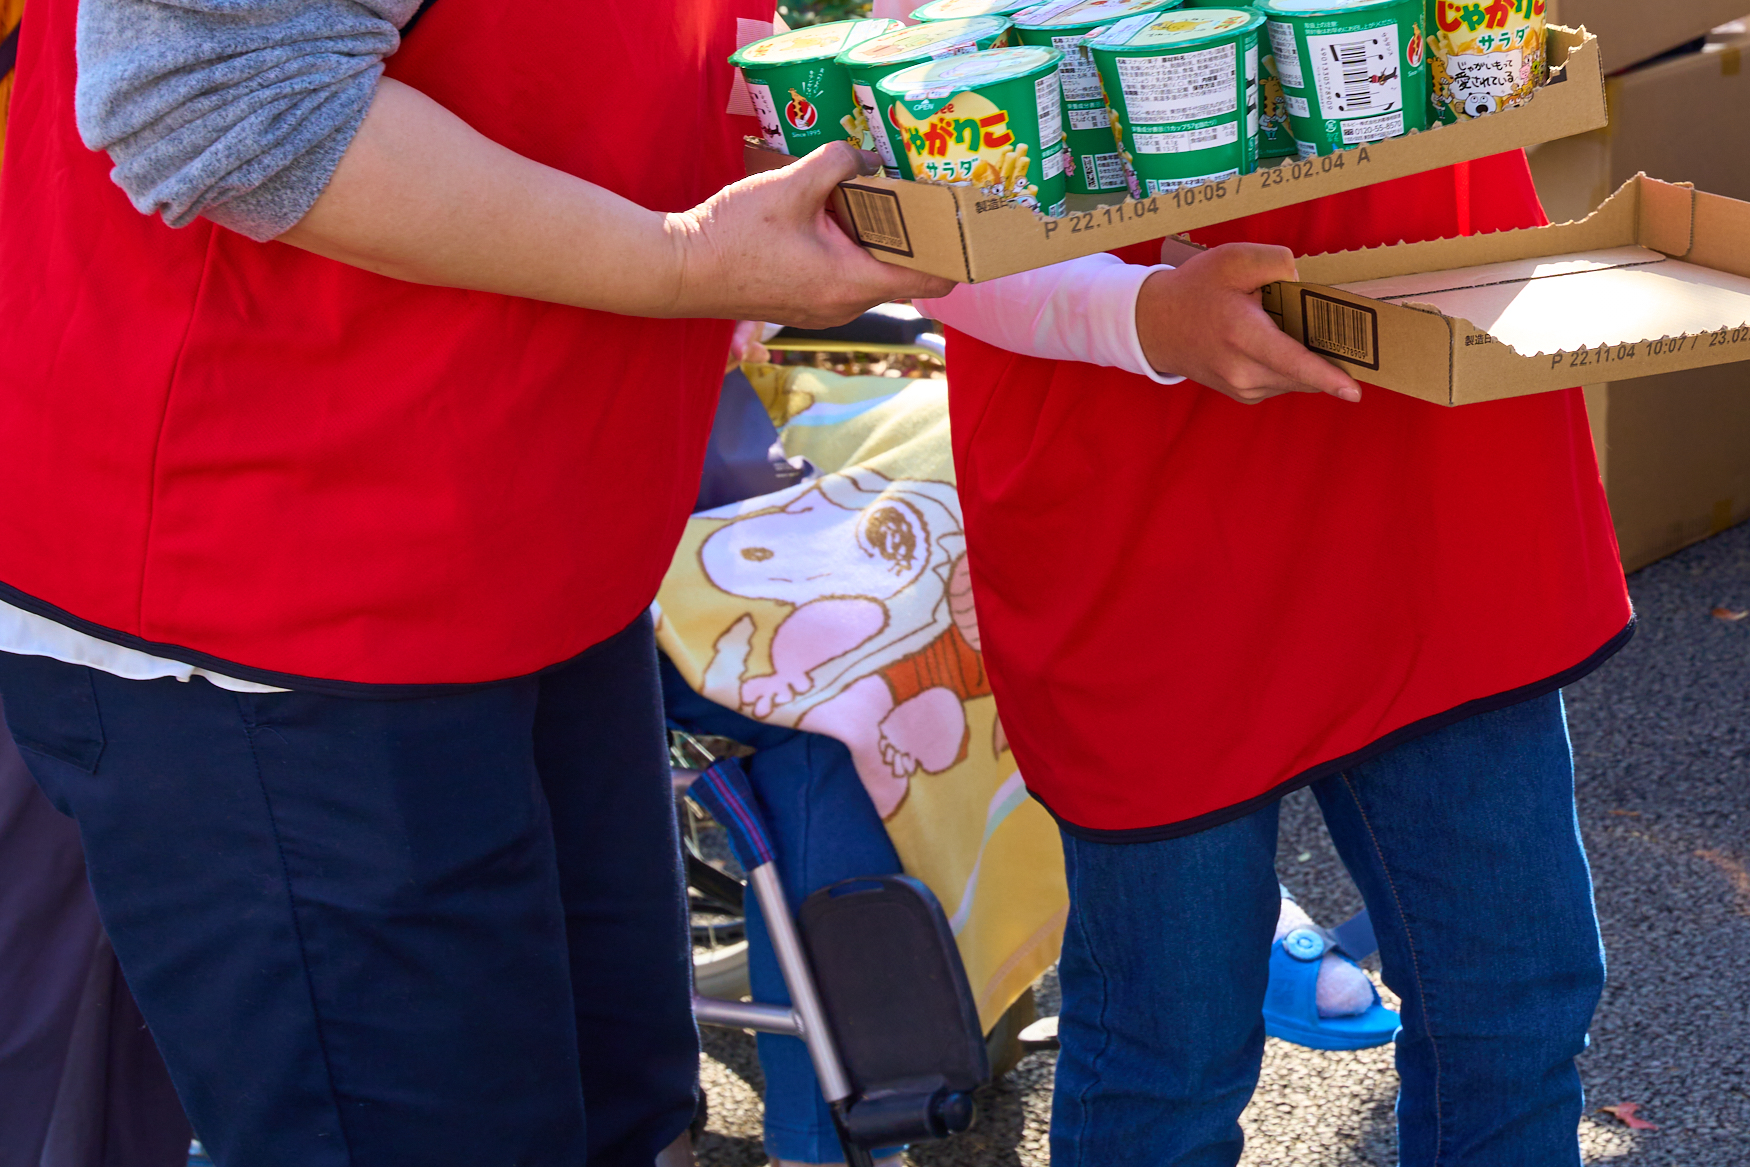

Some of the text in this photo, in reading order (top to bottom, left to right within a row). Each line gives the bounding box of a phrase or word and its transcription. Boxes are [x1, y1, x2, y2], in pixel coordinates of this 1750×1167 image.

[1478, 25, 1530, 52] サラダ
[1457, 59, 1513, 72] じゃがいもって
[1454, 70, 1514, 91] 愛されている
[913, 102, 934, 111] OPEN
[926, 156, 980, 179] サラダ
[1045, 221, 1058, 239] P
[1070, 198, 1159, 234] 22.11.04
[1172, 180, 1228, 209] 10:05
[1260, 152, 1344, 189] 23.02.04
[1357, 146, 1371, 165] A
[1551, 353, 1563, 370] P
[1569, 344, 1636, 368] 22.11.04
[1645, 336, 1688, 357] 10:07
